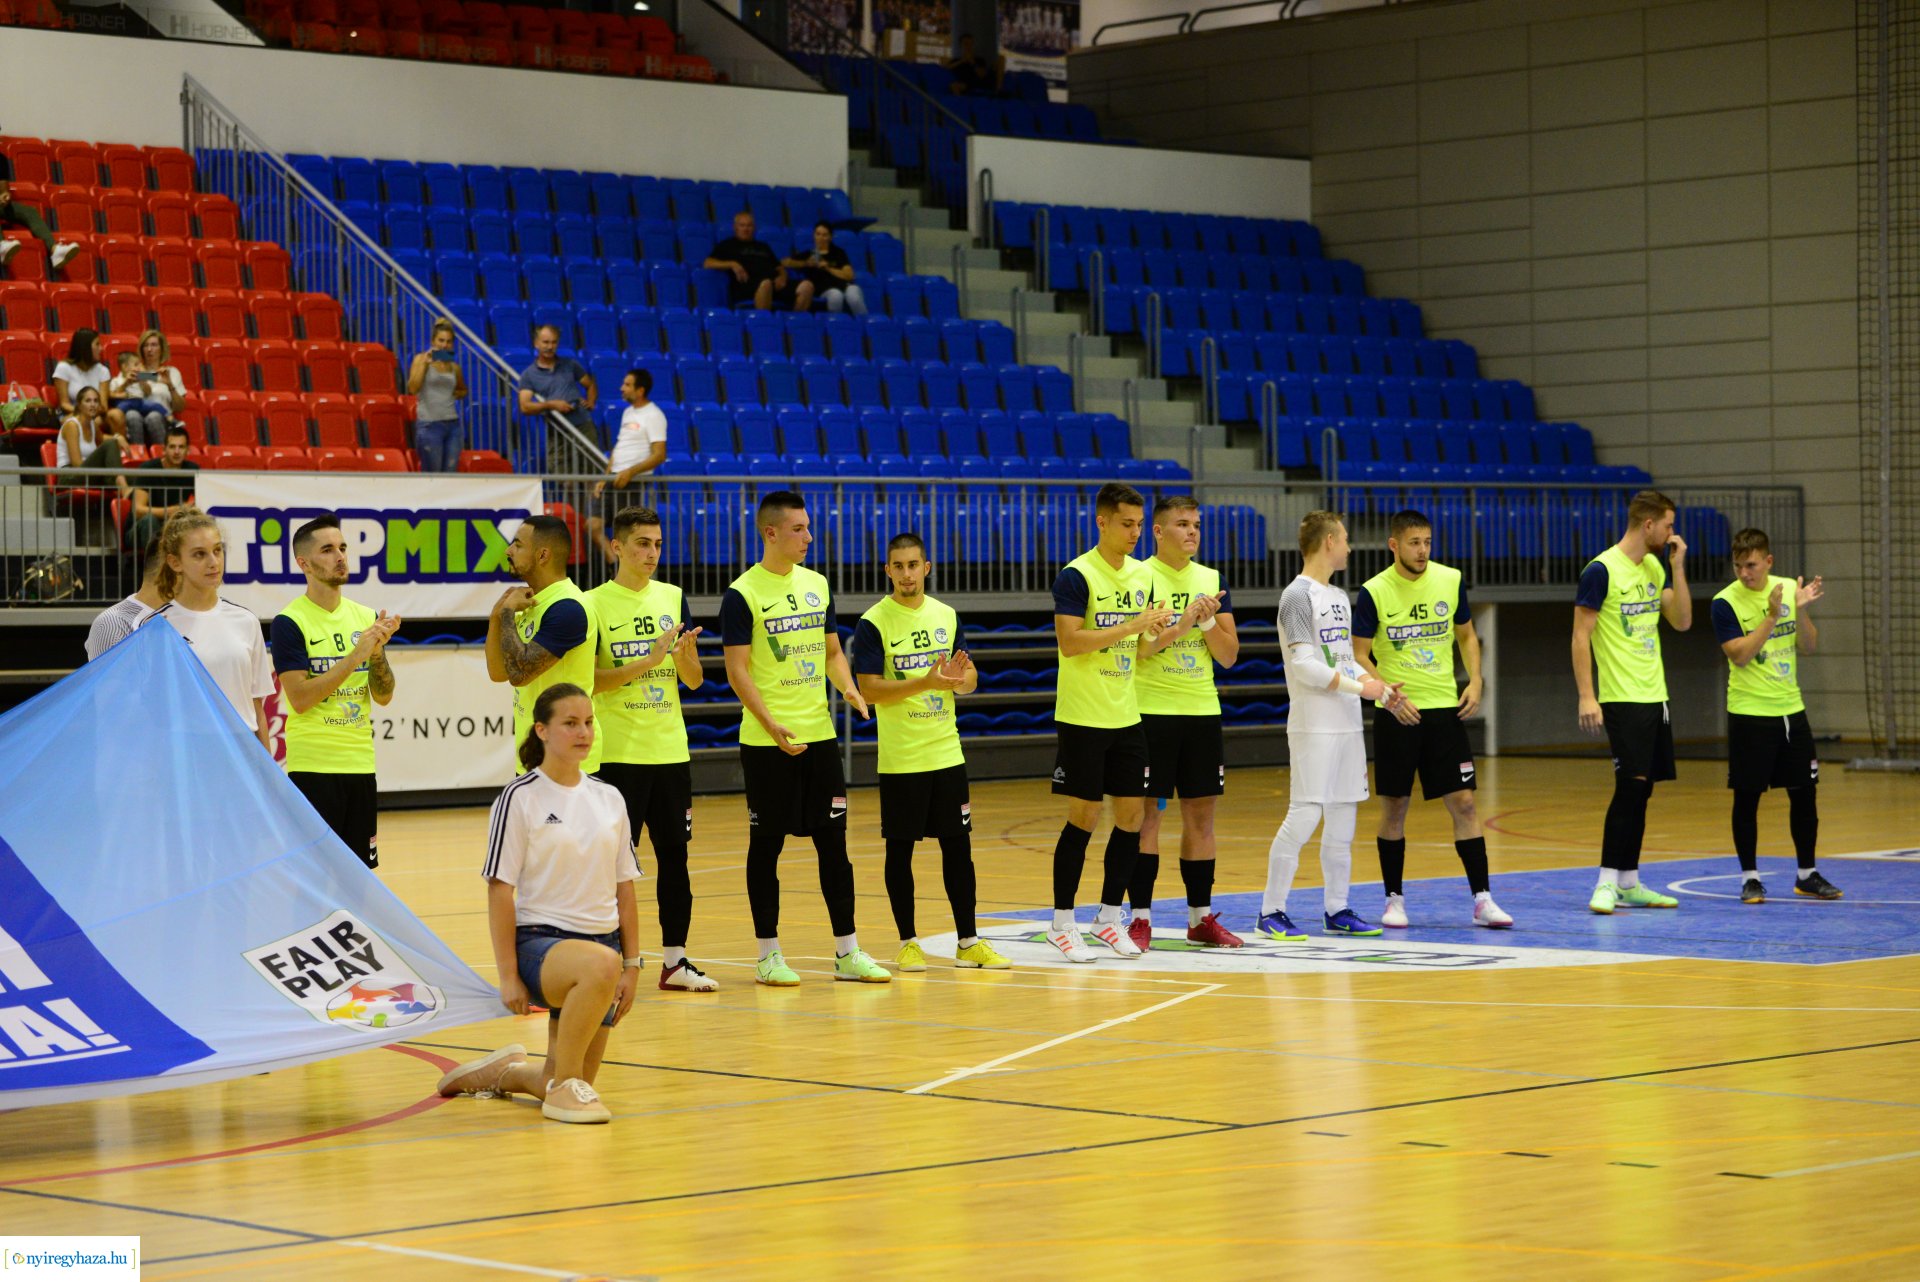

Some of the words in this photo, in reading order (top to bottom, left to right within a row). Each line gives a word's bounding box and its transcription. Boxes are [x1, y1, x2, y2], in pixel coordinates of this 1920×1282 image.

[208, 511, 527, 579] TiPMIX
[786, 593, 798, 611] 9
[1115, 591, 1131, 609] 24
[1171, 592, 1190, 610] 27
[1409, 604, 1428, 620] 45
[633, 615, 655, 636] 26
[333, 632, 346, 652] 8
[911, 629, 931, 649] 23
[259, 920, 368, 980] FAIR
[281, 942, 384, 999] PLAY
